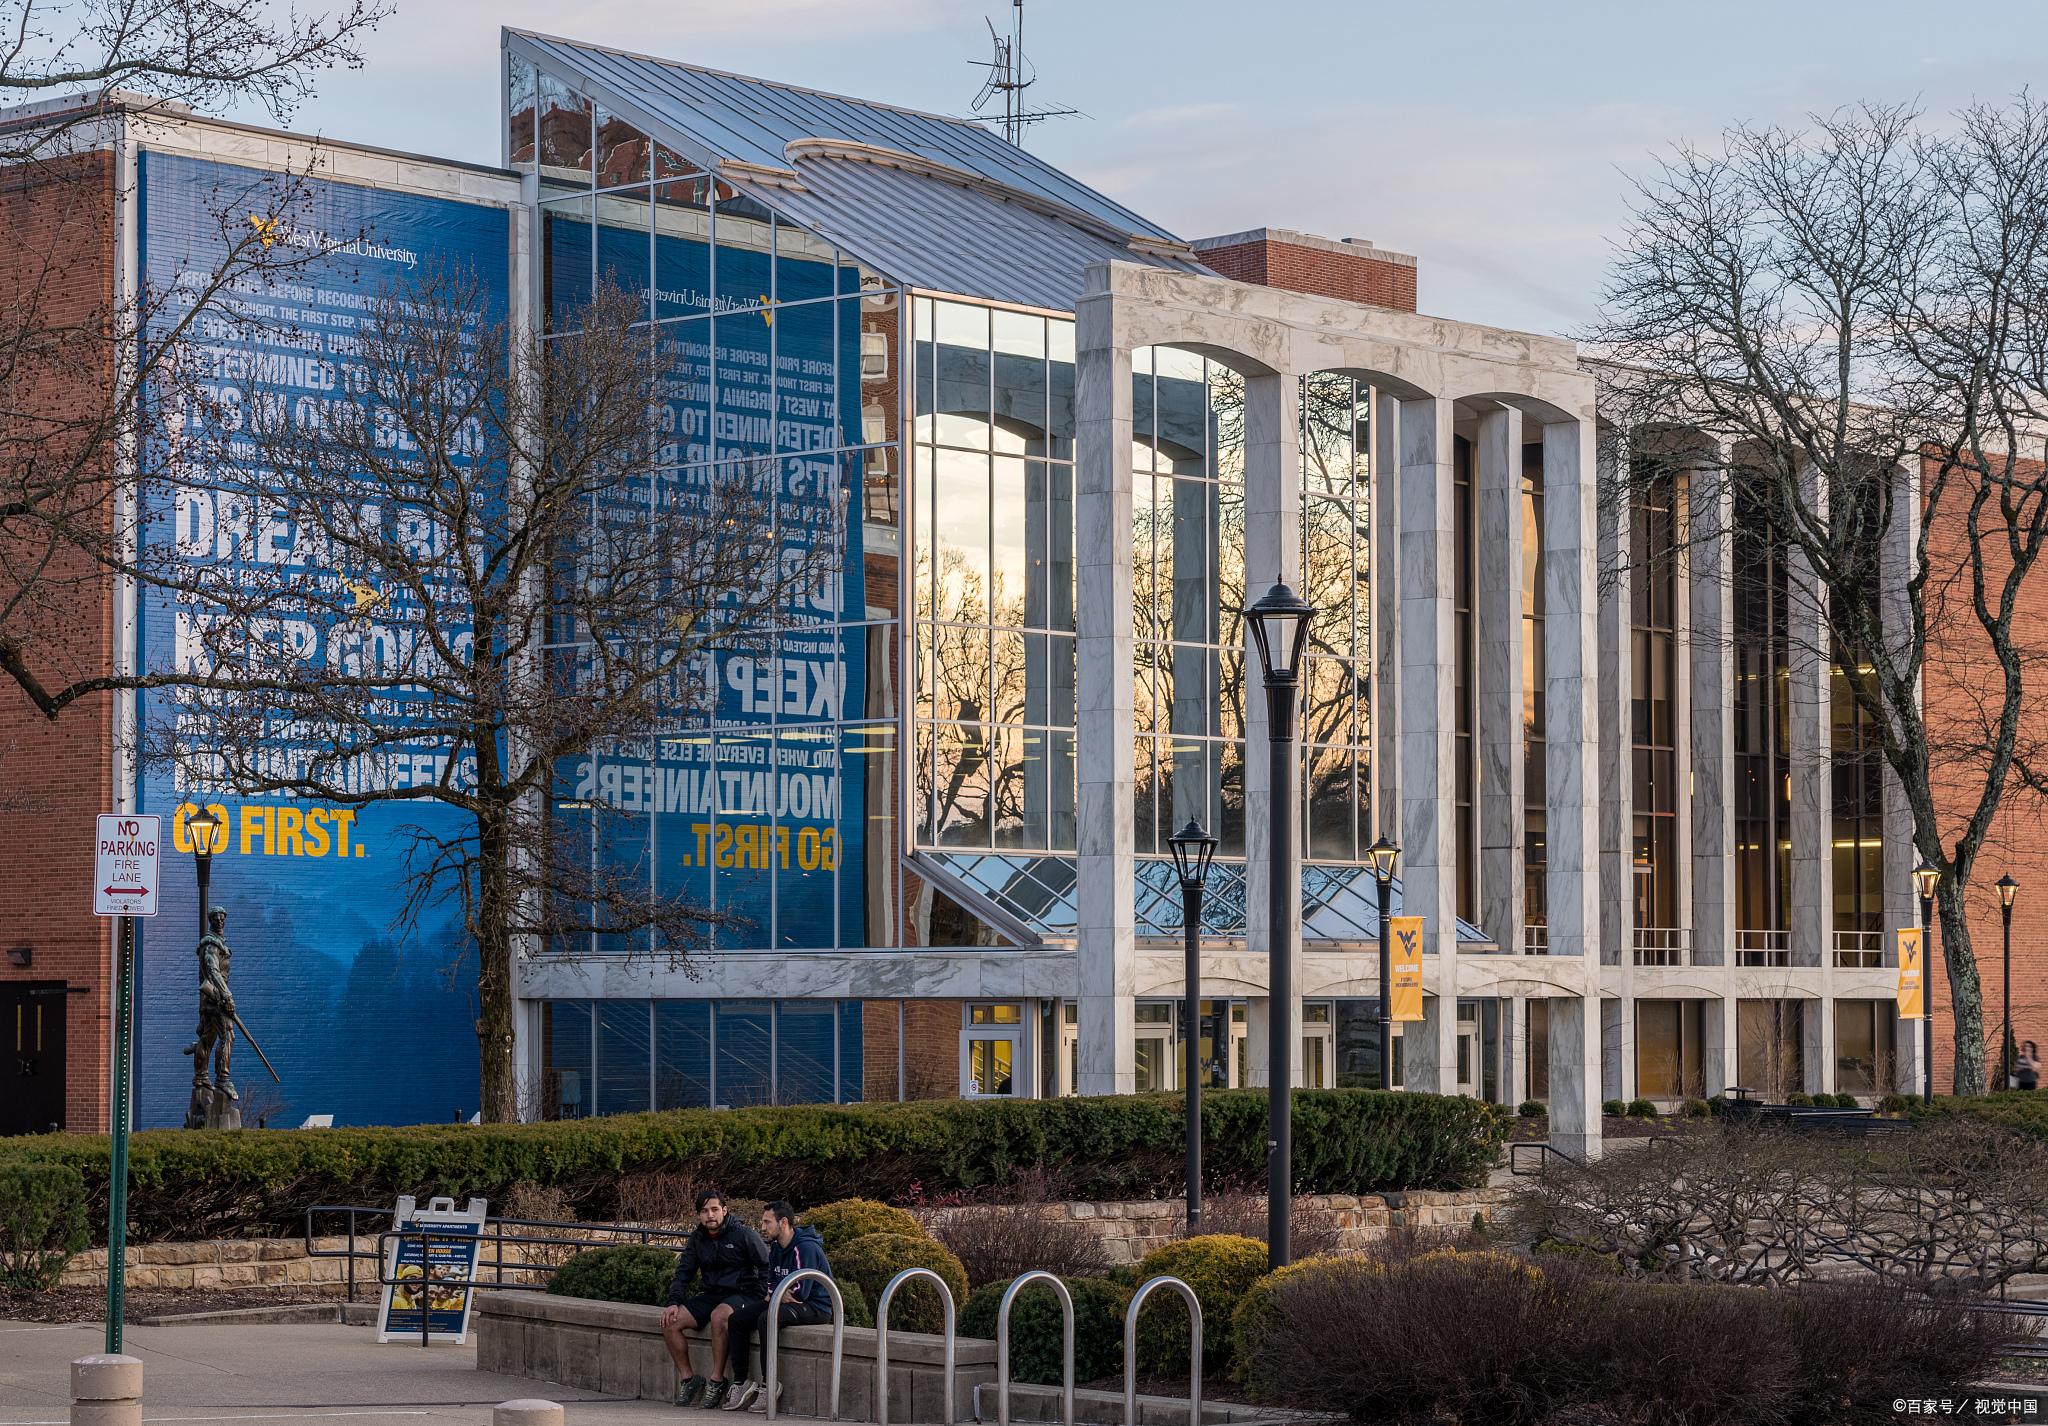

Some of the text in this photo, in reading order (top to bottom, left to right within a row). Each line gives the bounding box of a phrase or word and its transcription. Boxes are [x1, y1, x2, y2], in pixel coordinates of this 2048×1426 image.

[280, 306, 298, 321] THE
[301, 309, 328, 326] FIRST
[331, 313, 356, 329] STEP.
[175, 611, 318, 685] KEEP
[117, 821, 140, 836] NO
[240, 804, 365, 858] FIRST.
[100, 840, 155, 857] PARKING
[114, 860, 140, 870] FIRE
[112, 873, 141, 882] LANE
